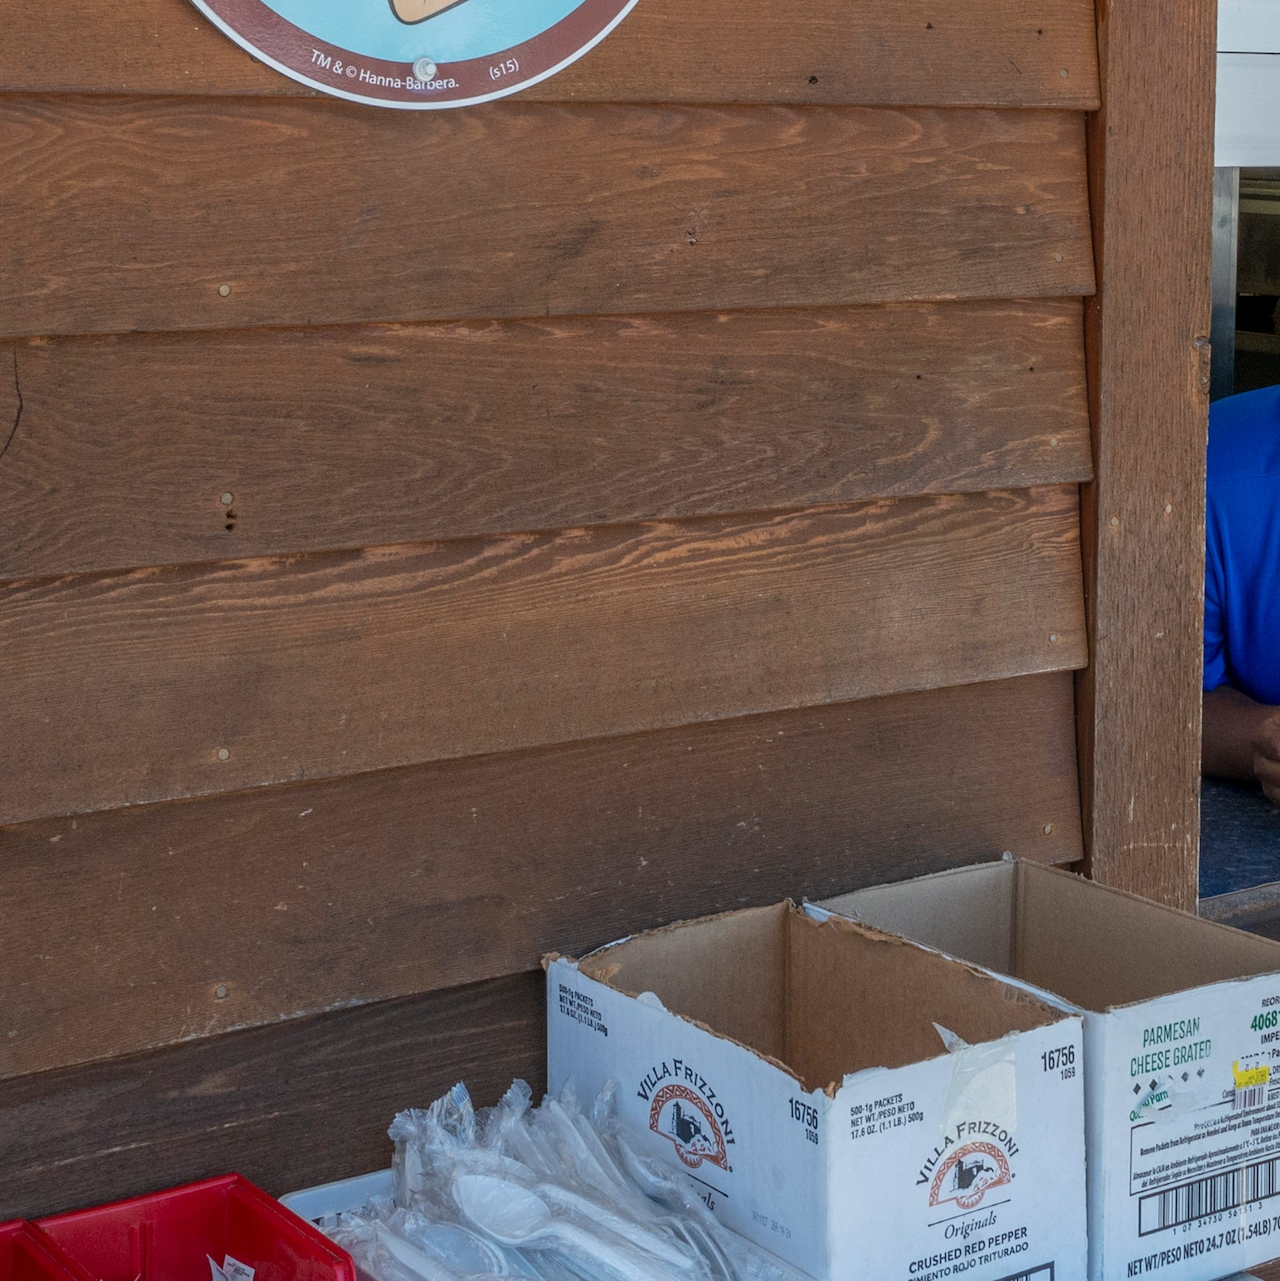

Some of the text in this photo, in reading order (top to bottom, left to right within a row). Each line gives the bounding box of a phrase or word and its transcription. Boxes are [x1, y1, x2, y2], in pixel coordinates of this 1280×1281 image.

[311, 49, 331, 70] TM
[332, 60, 343, 75] &
[489, 58, 520, 81] (s15)
[1143, 1017, 1200, 1048] PARMESAN
[1041, 1044, 1075, 1072] 16756
[1060, 1066, 1076, 1081] 1059
[1130, 1039, 1212, 1077] CHEESE GRATED
[637, 1058, 736, 1145] VILLA FRIZZONI
[788, 1097, 819, 1130] 16756
[850, 1093, 903, 1117] 500-1g PACKETS
[851, 1116, 863, 1128] NET
[897, 1101, 915, 1115] NETO
[805, 1128, 819, 1145] 1059
[851, 1127, 865, 1139] 17.6
[867, 1124, 878, 1135] OZ.
[879, 1119, 891, 1133] (1.1
[907, 1111, 923, 1123] 500g
[916, 1120, 1019, 1188] VILLA FRIZZONI
[944, 1210, 997, 1240] Originals
[1182, 1223, 1192, 1233] 07
[1198, 1214, 1223, 1228] 34730
[909, 1226, 1028, 1274] CRUSHED RED PEPPER
[952, 1258, 977, 1275] ROJO
[978, 1241, 1029, 1270] TRITURADO
[1127, 1258, 1143, 1278] NET
[1144, 1245, 1182, 1272] WT/PESO
[1183, 1239, 1205, 1260] NETO
[1206, 1234, 1224, 1253] 24.7
[1225, 1229, 1237, 1246] OZ
[1237, 1218, 1271, 1245] (1.54LB)
